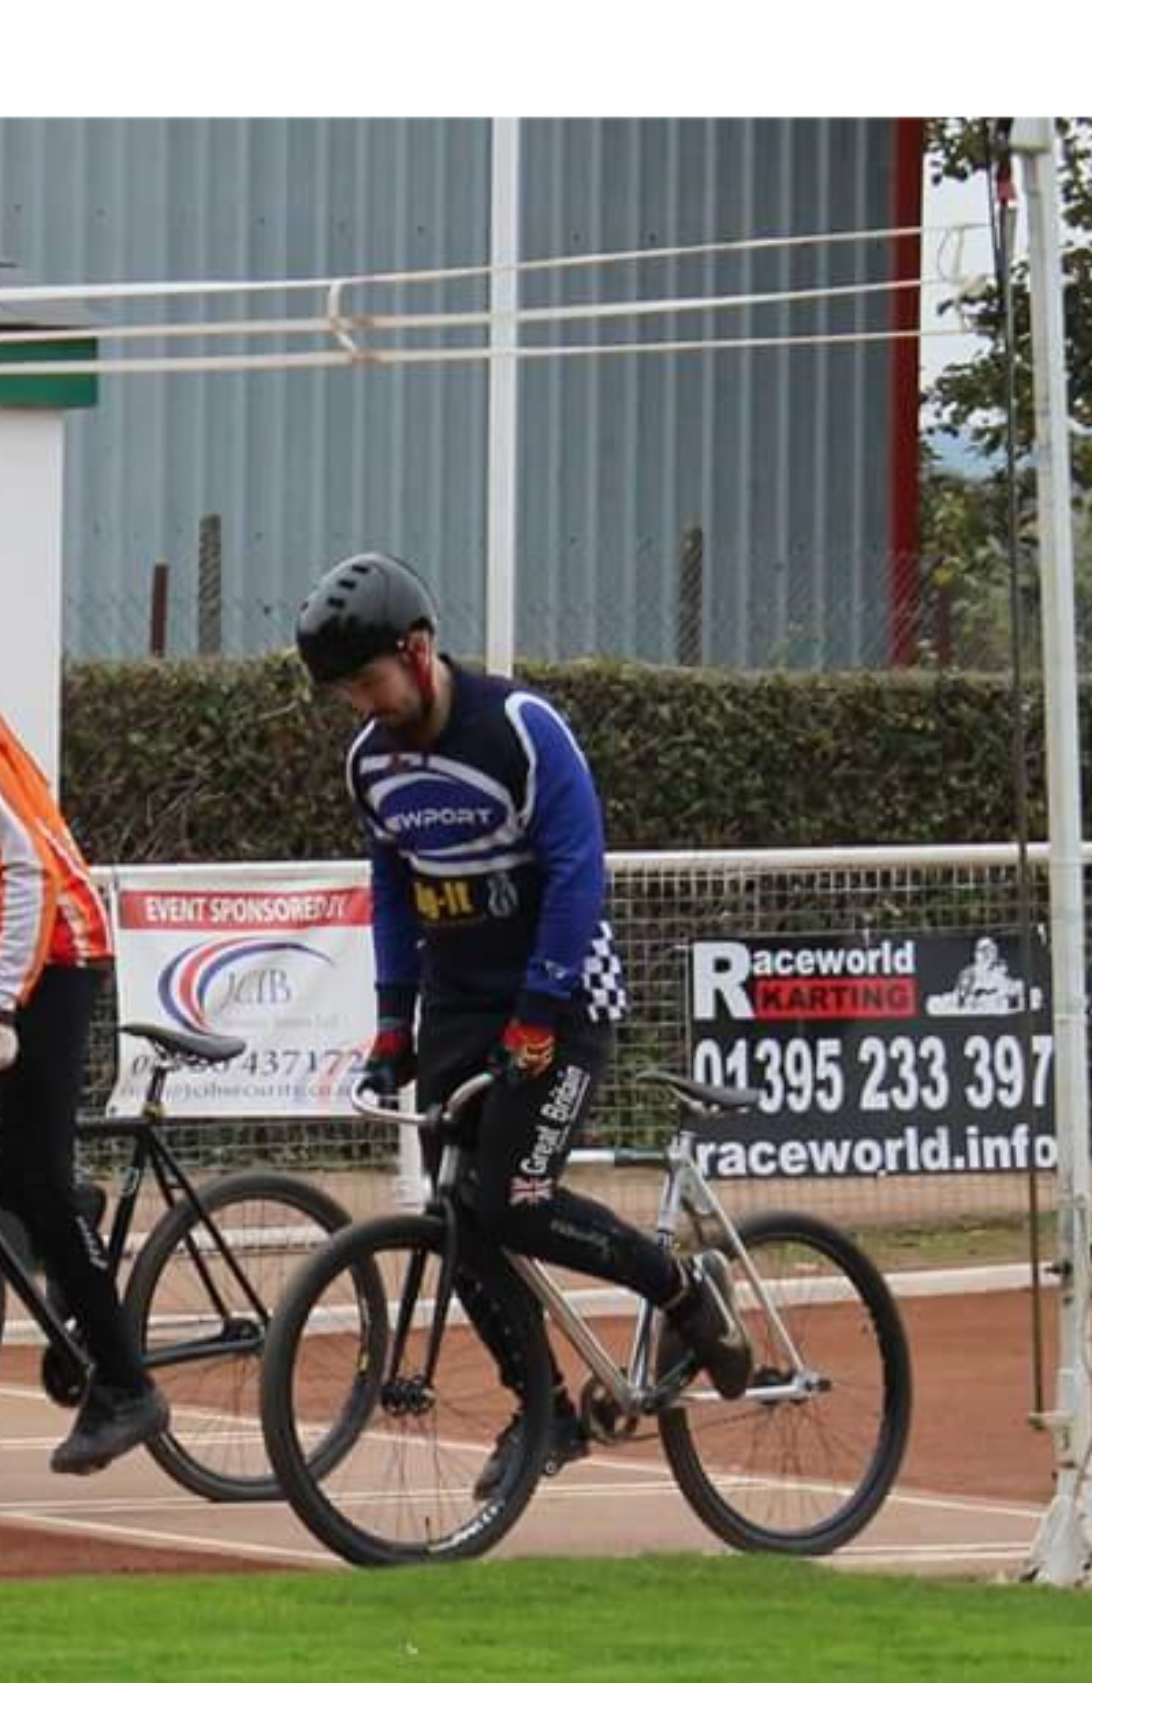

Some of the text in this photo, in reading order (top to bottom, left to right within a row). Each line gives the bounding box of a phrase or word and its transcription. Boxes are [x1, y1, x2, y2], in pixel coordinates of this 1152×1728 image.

[146, 895, 204, 922] EVENT
[209, 894, 326, 923] SPONSORED
[693, 941, 917, 1020] Raceworld
[762, 982, 910, 1011] KARTING
[694, 1034, 1054, 1114] 01395 233 397
[520, 1123, 561, 1175] Great
[696, 1122, 1058, 1176] raceworld.info
